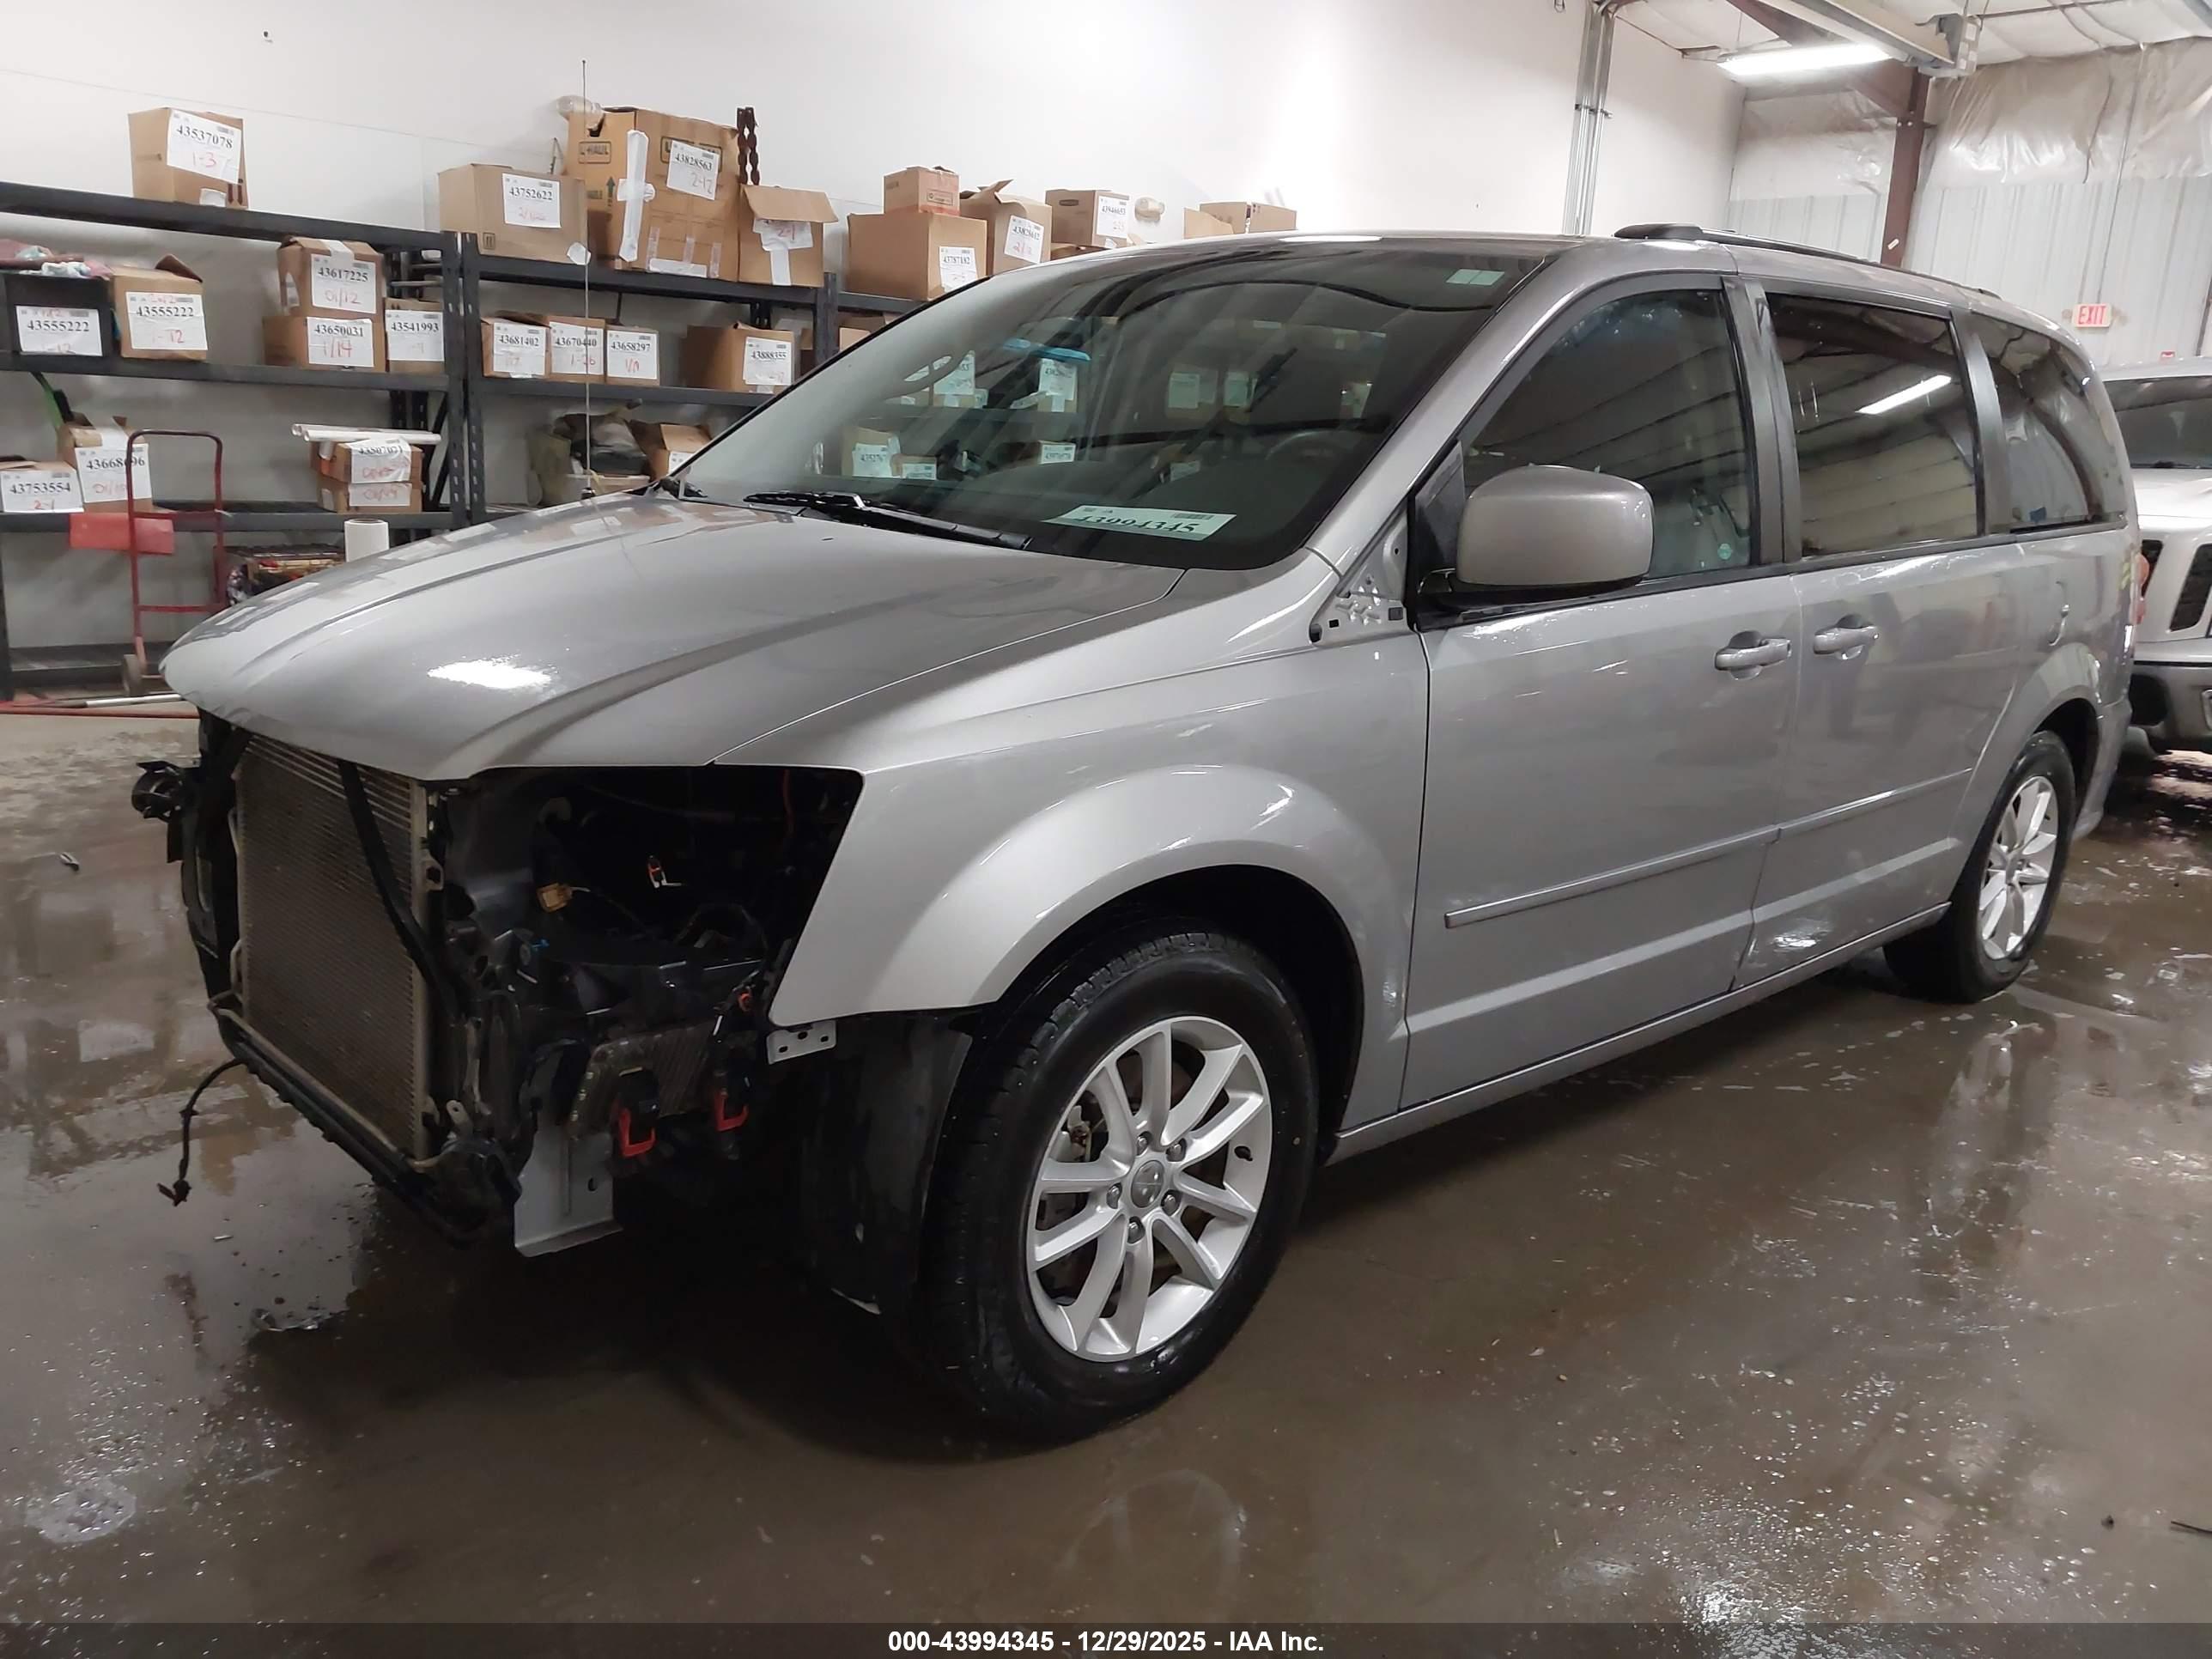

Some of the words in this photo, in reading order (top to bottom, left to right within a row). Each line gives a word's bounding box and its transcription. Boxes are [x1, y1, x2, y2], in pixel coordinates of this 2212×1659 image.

[176, 125, 233, 149] 43537078
[675, 153, 712, 171] 43828563
[509, 186, 552, 200] 43752622
[318, 267, 368, 283] 43617225
[136, 306, 194, 317] 43555222
[2078, 305, 2106, 325] EXIT
[27, 319, 89, 332] 43555222
[313, 324, 363, 337] 43650031
[391, 322, 440, 333] 43541993
[499, 334, 539, 347] 43681402
[556, 337, 597, 347] 43670440
[611, 341, 651, 352] 43658297
[9, 482, 71, 495] 43753554
